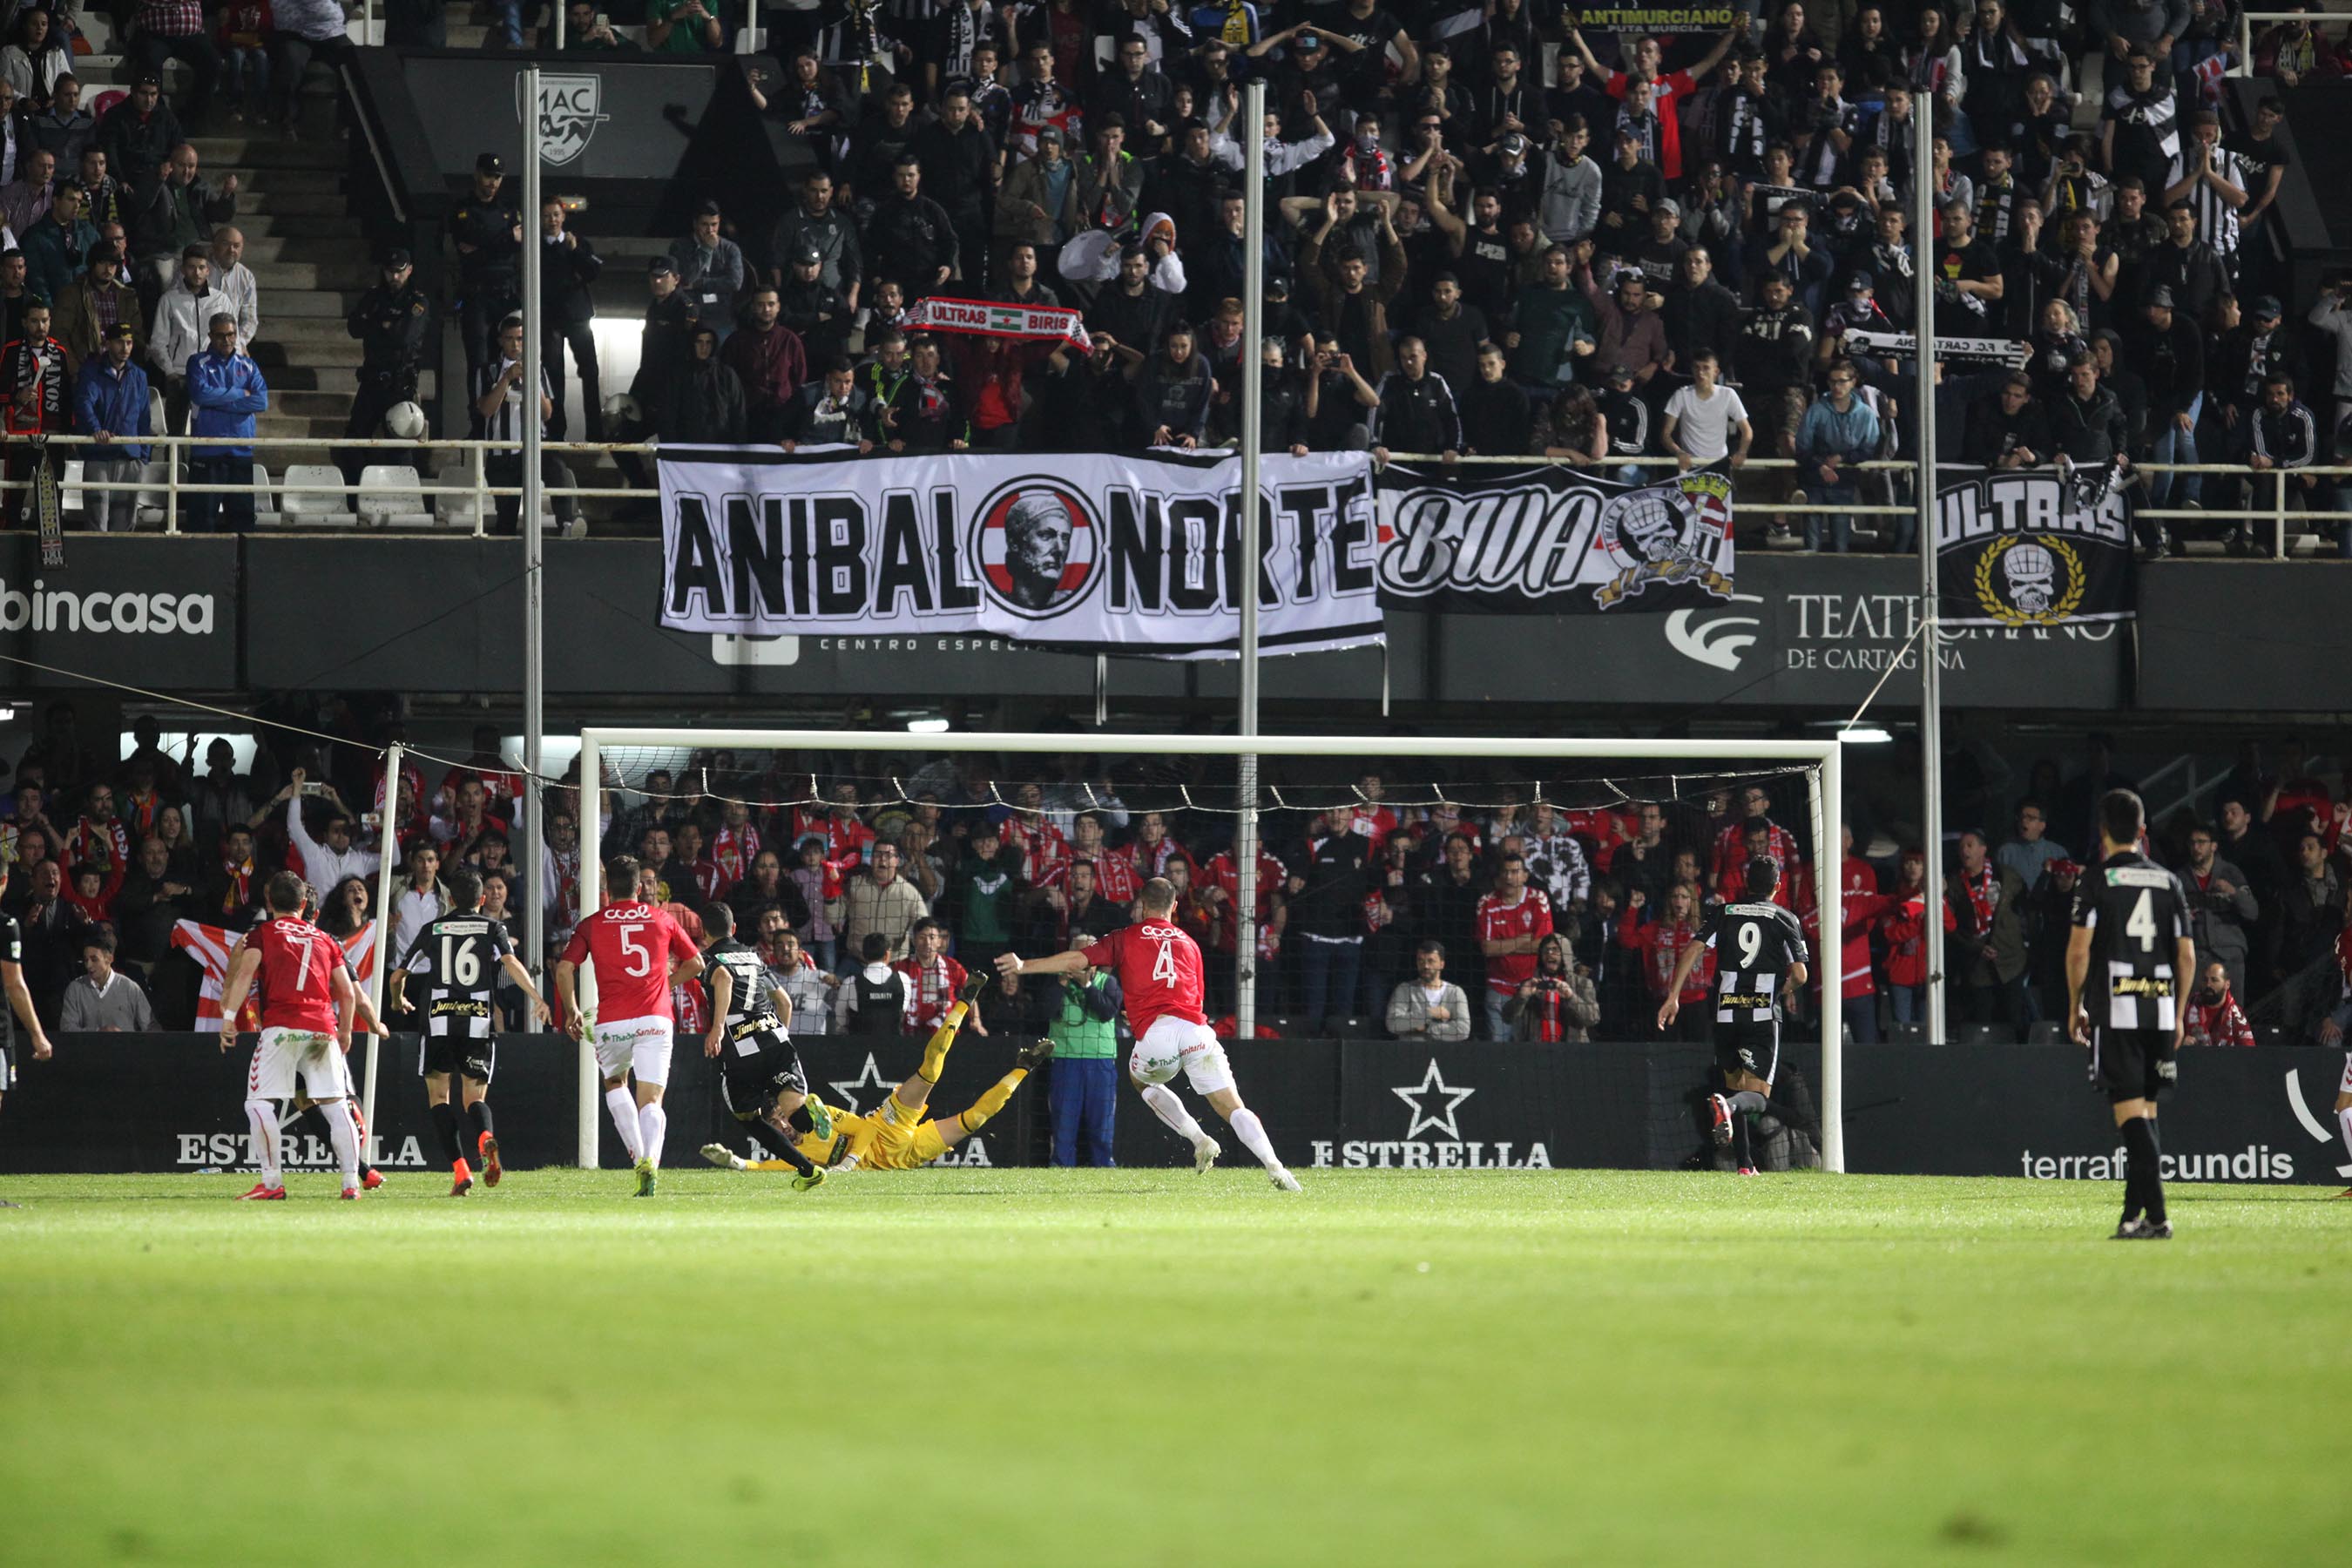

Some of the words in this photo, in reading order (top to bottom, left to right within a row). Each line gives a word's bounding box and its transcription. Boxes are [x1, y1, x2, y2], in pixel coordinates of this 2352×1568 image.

[1581, 10, 1733, 24] ANTIMURCIANO
[932, 306, 987, 324] ULTRAS
[1028, 315, 1069, 329] BIRIS
[1936, 480, 2126, 550] ULTRAS
[670, 491, 981, 615] ANIBAL
[1109, 476, 1375, 610] NORTE
[1379, 486, 1603, 595] BWA
[0, 578, 214, 634] bincasa
[820, 639, 917, 651] CENTRO
[1787, 649, 1816, 669] DE
[1824, 648, 1966, 672] CARTAGNA
[2126, 888, 2158, 953] 4
[286, 935, 313, 992] 7
[441, 936, 480, 986] 16
[620, 924, 651, 977] 5
[1152, 940, 1177, 989] 4
[1738, 922, 1761, 969] 9
[735, 965, 758, 1011] 7
[176, 1133, 428, 1166] ESTRELA
[1310, 1140, 1555, 1169] ESTRELLA
[2021, 1145, 2295, 1179] terrafcundis
